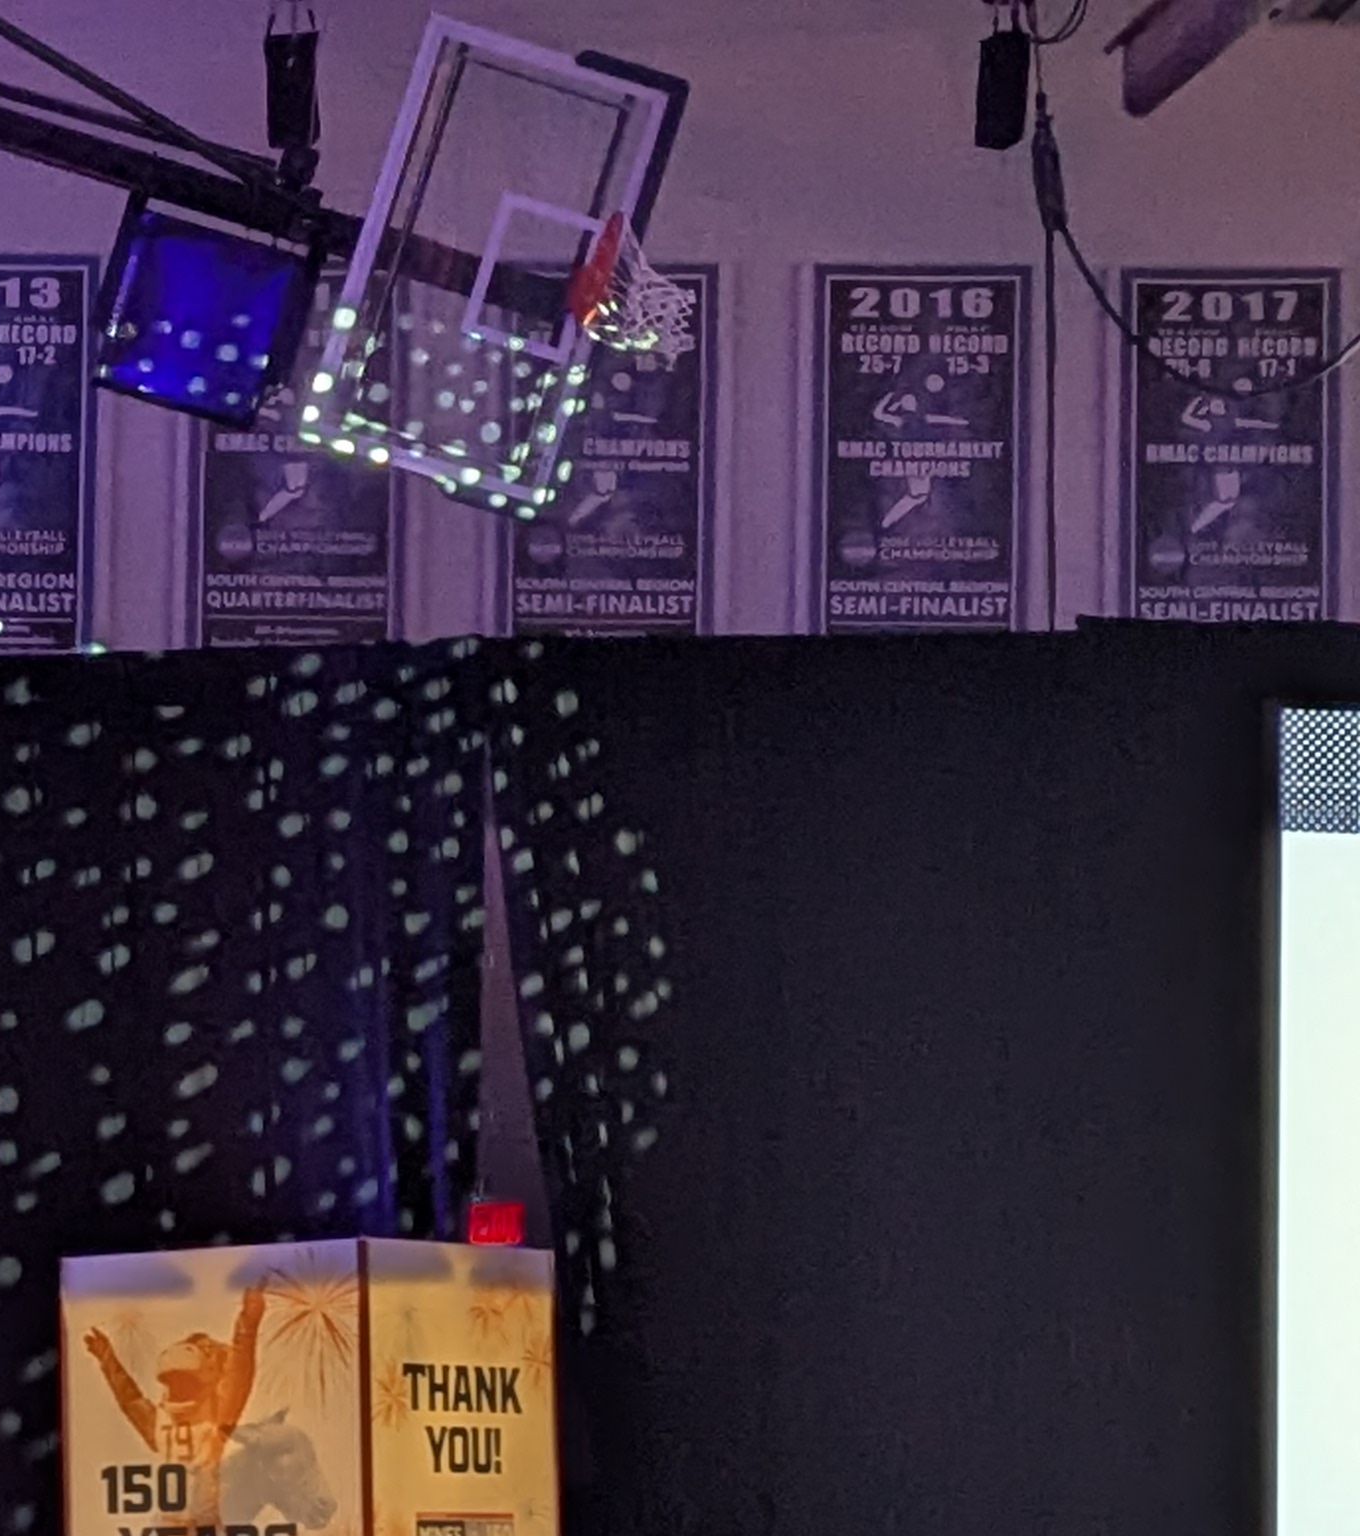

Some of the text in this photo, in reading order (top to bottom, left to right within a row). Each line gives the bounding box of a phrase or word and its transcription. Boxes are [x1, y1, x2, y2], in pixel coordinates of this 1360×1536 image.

[850, 287, 994, 318] 2016
[1162, 290, 1298, 322] 2017
[842, 333, 1008, 354] RECORD RECORD
[1149, 336, 1317, 357] RECORD RECORD
[16, 346, 57, 365] 17-2
[838, 440, 1005, 459] RMAC TOURNAMENT
[1203, 444, 1313, 464] CHAMPIONS
[869, 460, 972, 478] CHAMPIONS
[206, 574, 257, 587] SOUTH
[831, 580, 880, 592] SOUTH
[206, 591, 385, 609] QUARTERFINALIST
[515, 594, 693, 615] SEMI-FINALIST
[831, 595, 1007, 616] SEMI-FINALIST
[1140, 602, 1319, 621] SEMI-FINALIST
[402, 1362, 523, 1415] THANK
[425, 1425, 502, 1474] YOU!
[101, 1464, 187, 1515] 150
